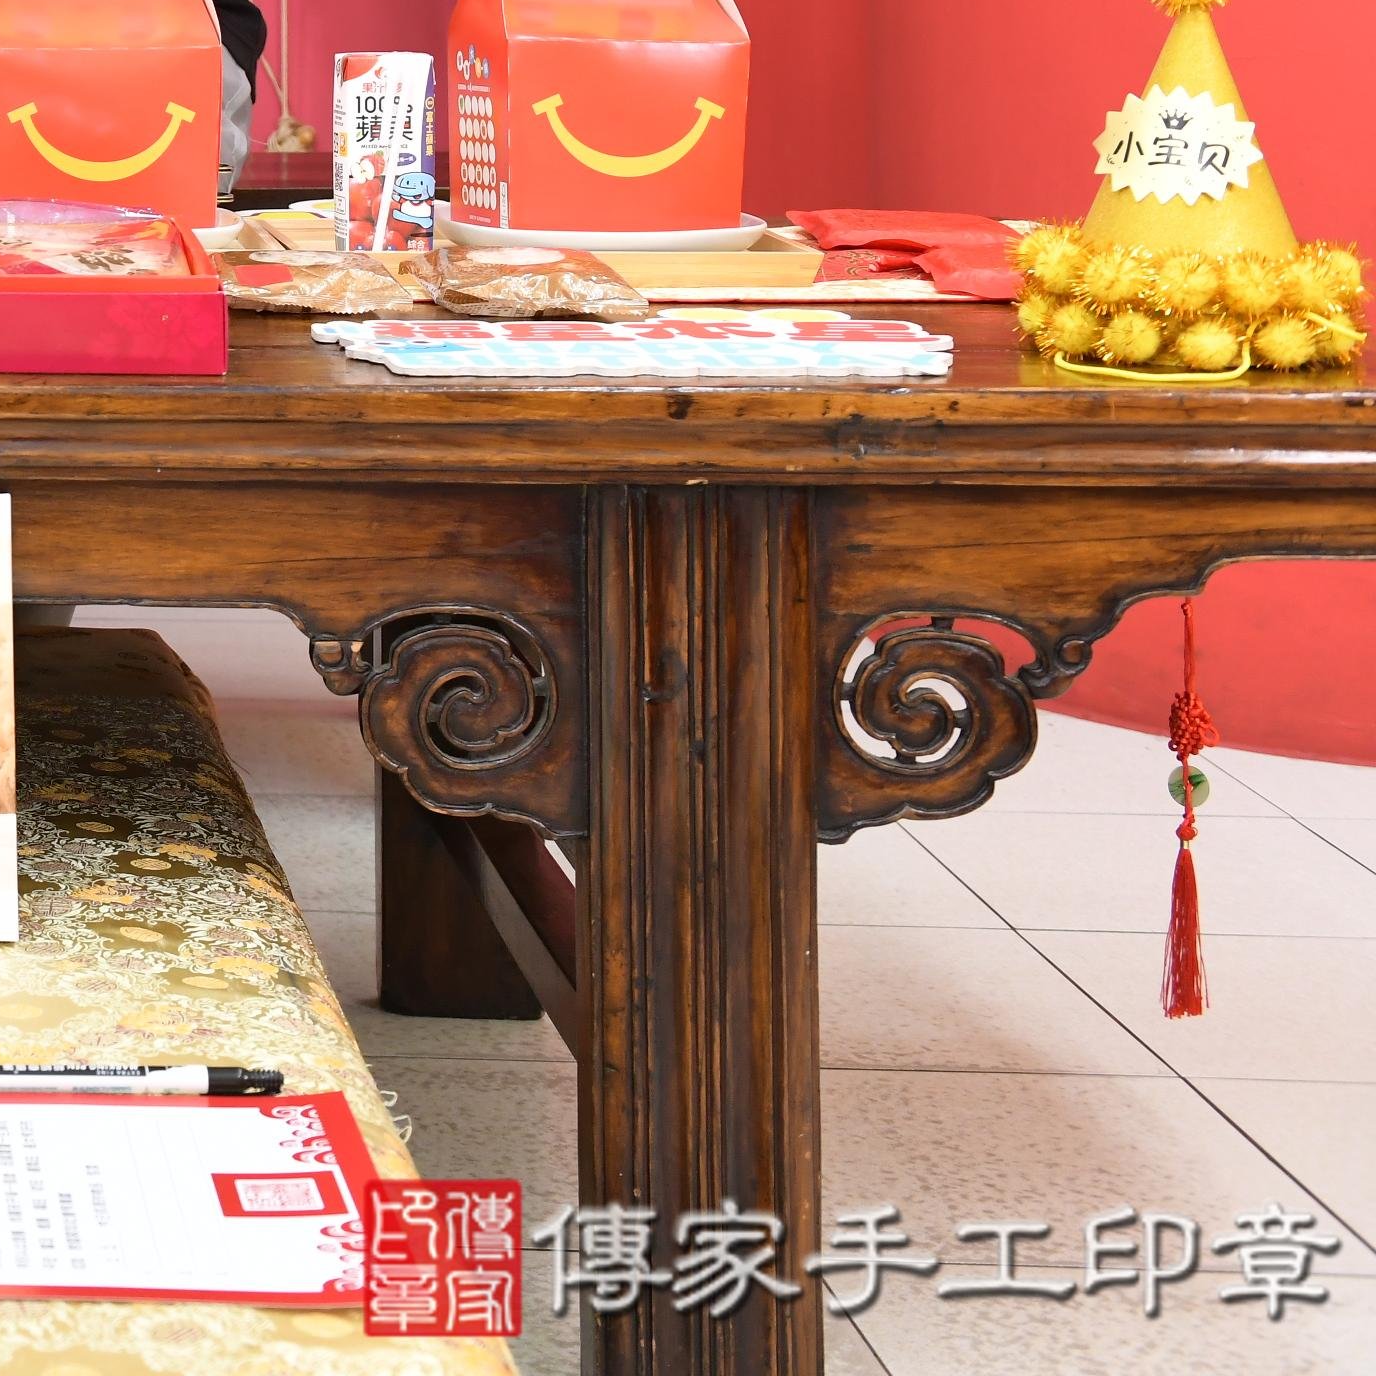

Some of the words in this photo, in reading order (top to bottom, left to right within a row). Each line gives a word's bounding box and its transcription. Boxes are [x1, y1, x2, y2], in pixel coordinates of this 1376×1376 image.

[1113, 131, 1230, 176] 小宝贝
[370, 319, 941, 342] 福星本星
[390, 353, 938, 367] BIRTHDAY
